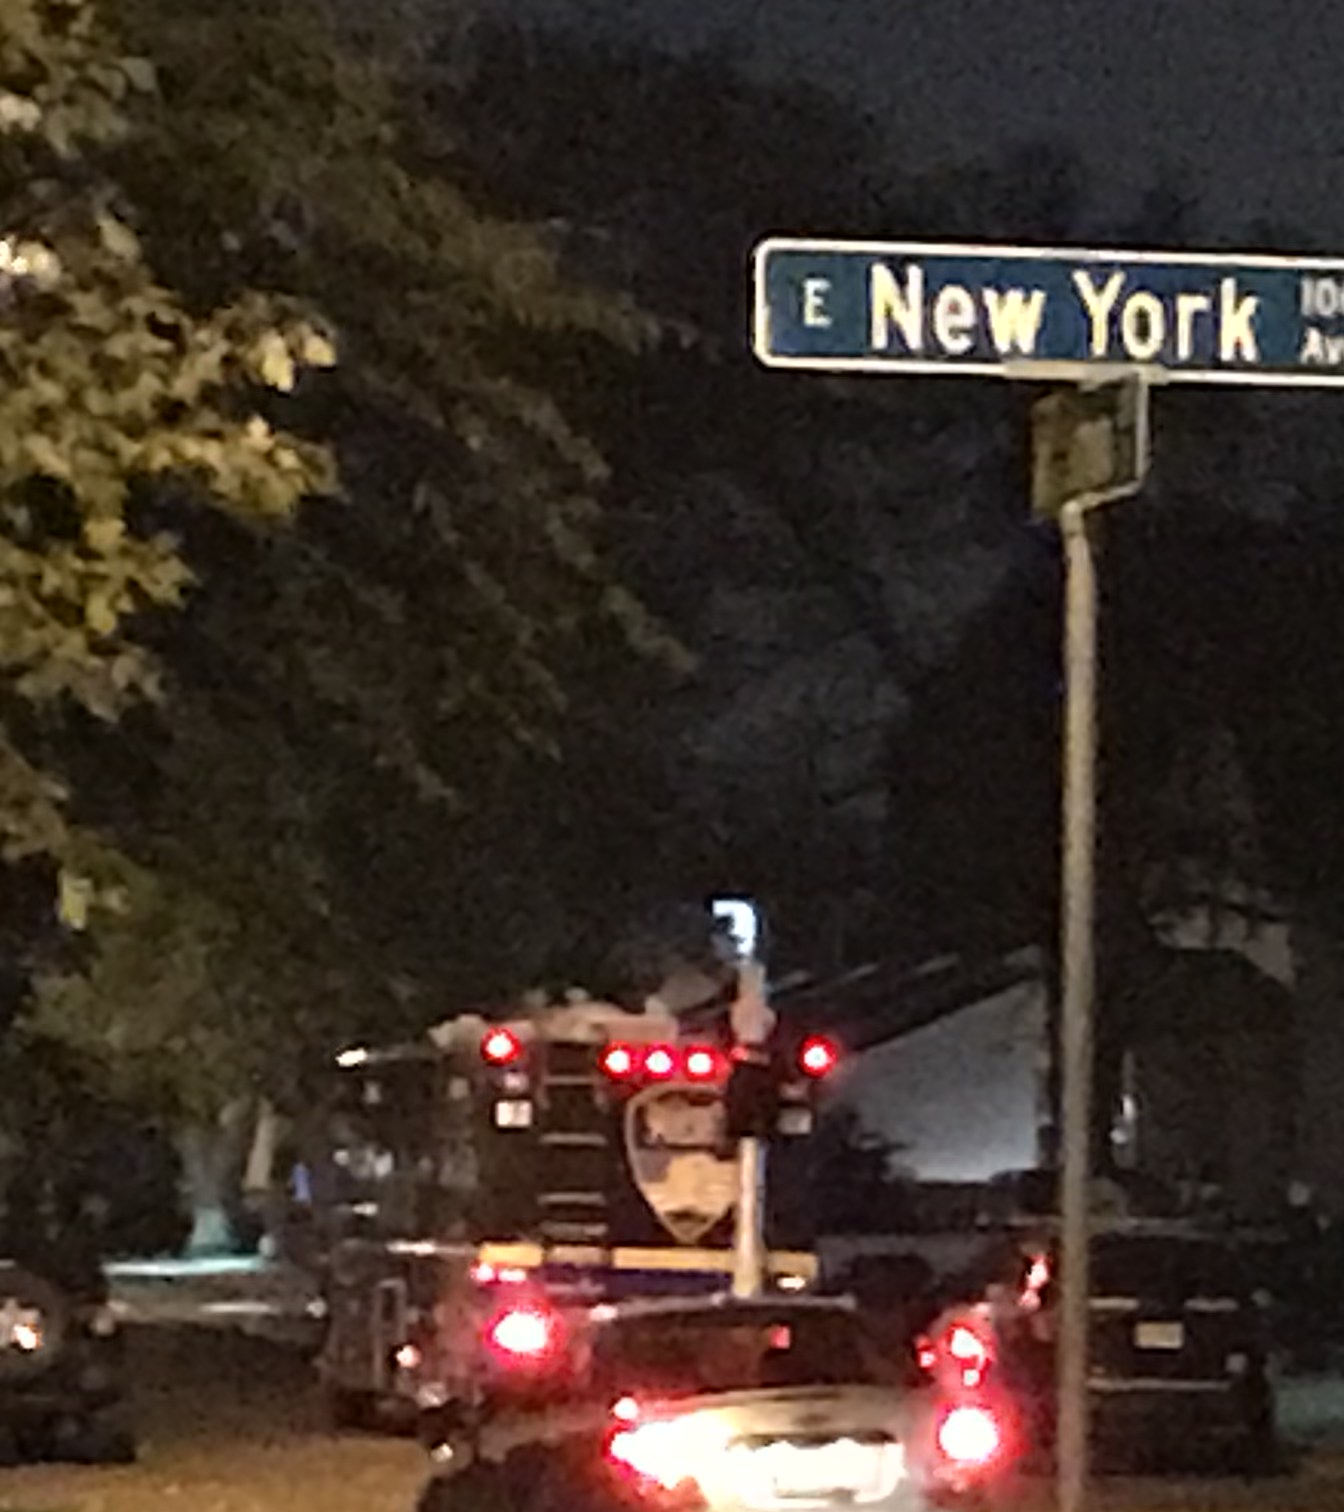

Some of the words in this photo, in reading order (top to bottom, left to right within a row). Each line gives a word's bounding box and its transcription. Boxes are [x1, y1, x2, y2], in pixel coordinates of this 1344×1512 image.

[803, 280, 833, 328] E
[869, 263, 1046, 355] New
[1072, 270, 1260, 362] York
